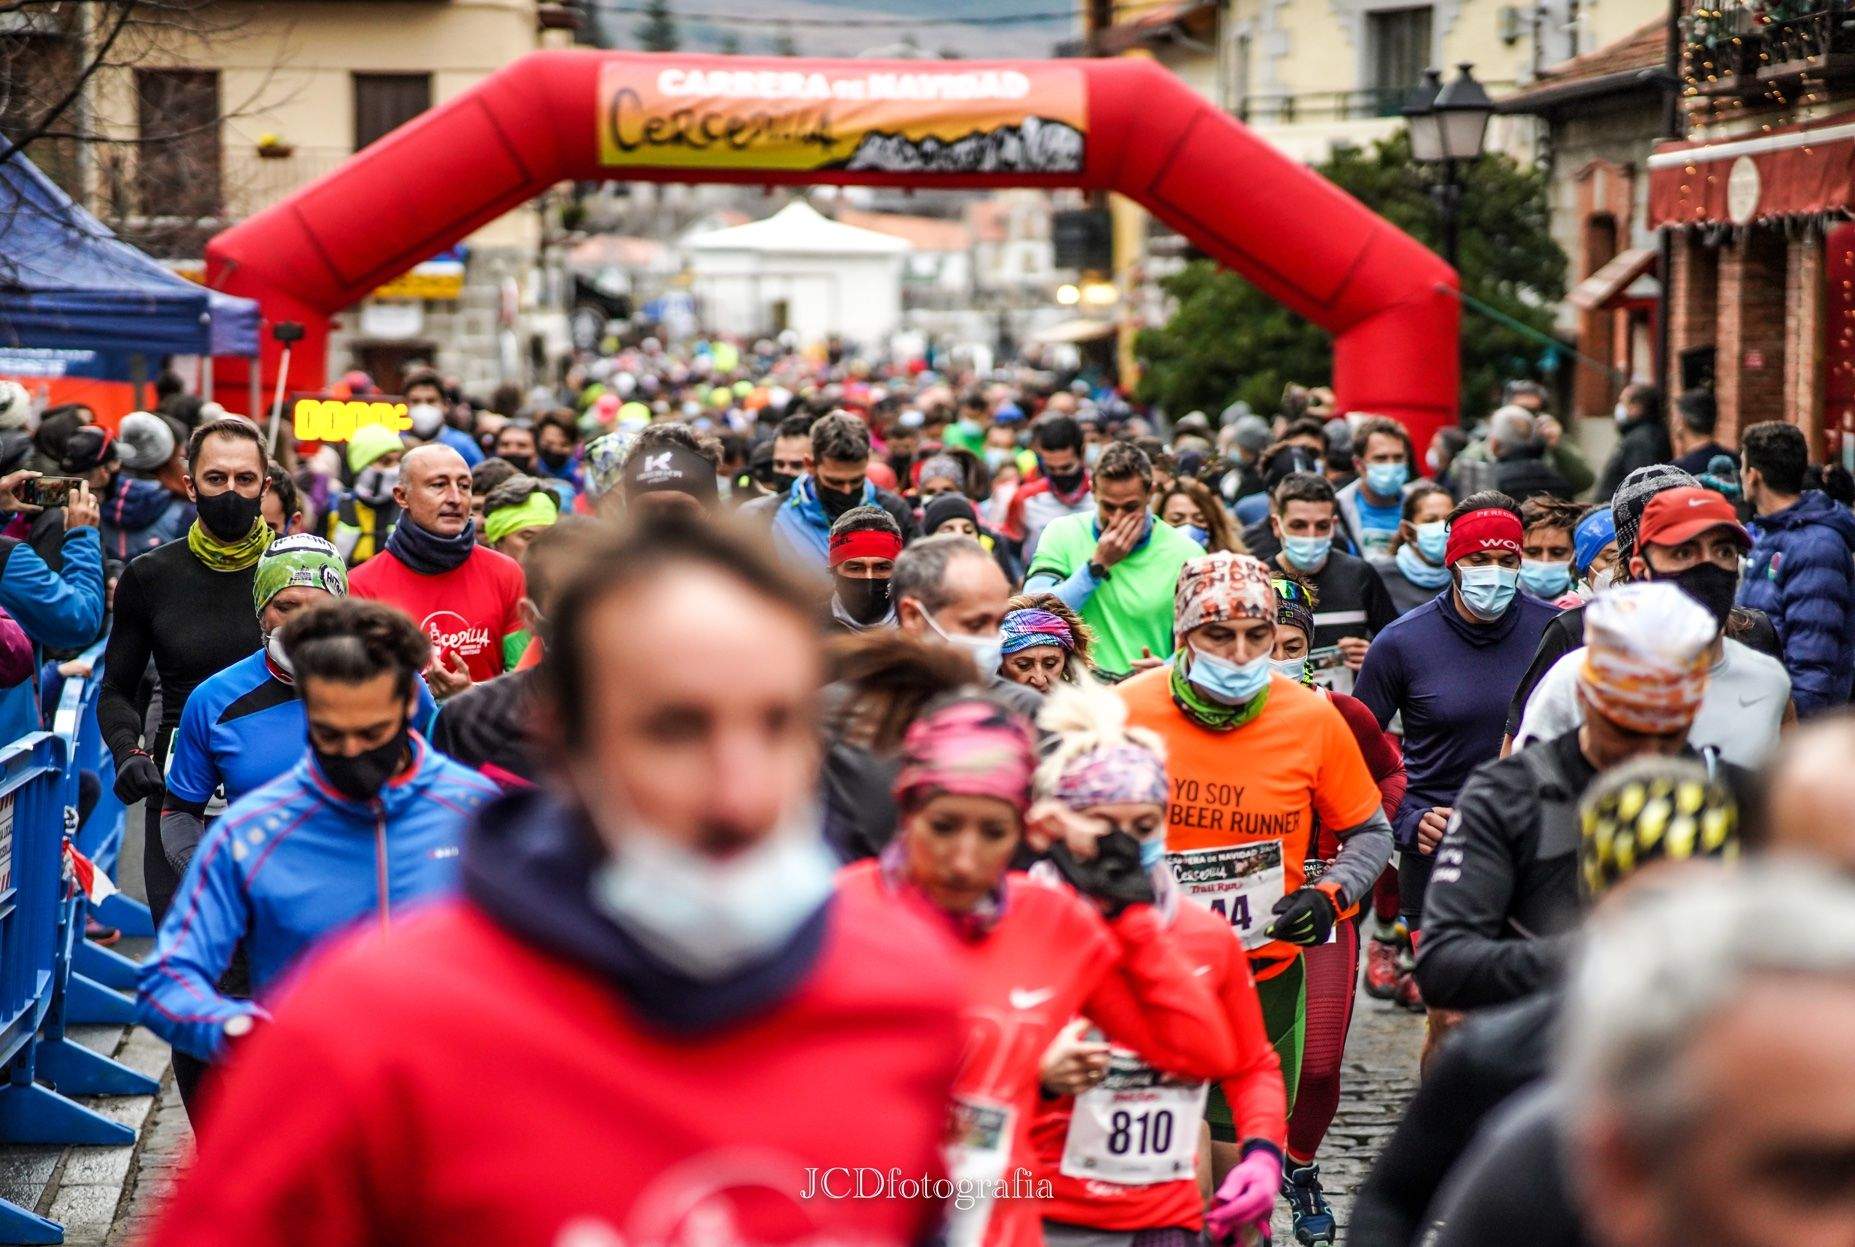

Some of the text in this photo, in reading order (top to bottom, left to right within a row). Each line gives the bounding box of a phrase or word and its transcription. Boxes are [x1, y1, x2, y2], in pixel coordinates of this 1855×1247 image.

[657, 69, 831, 98] CARRERA
[1174, 778, 1245, 807] YO SOY
[1169, 804, 1300, 836] BEER RUNNER
[1218, 849, 1258, 862] NAVIDAD
[1108, 1110, 1173, 1155] 810
